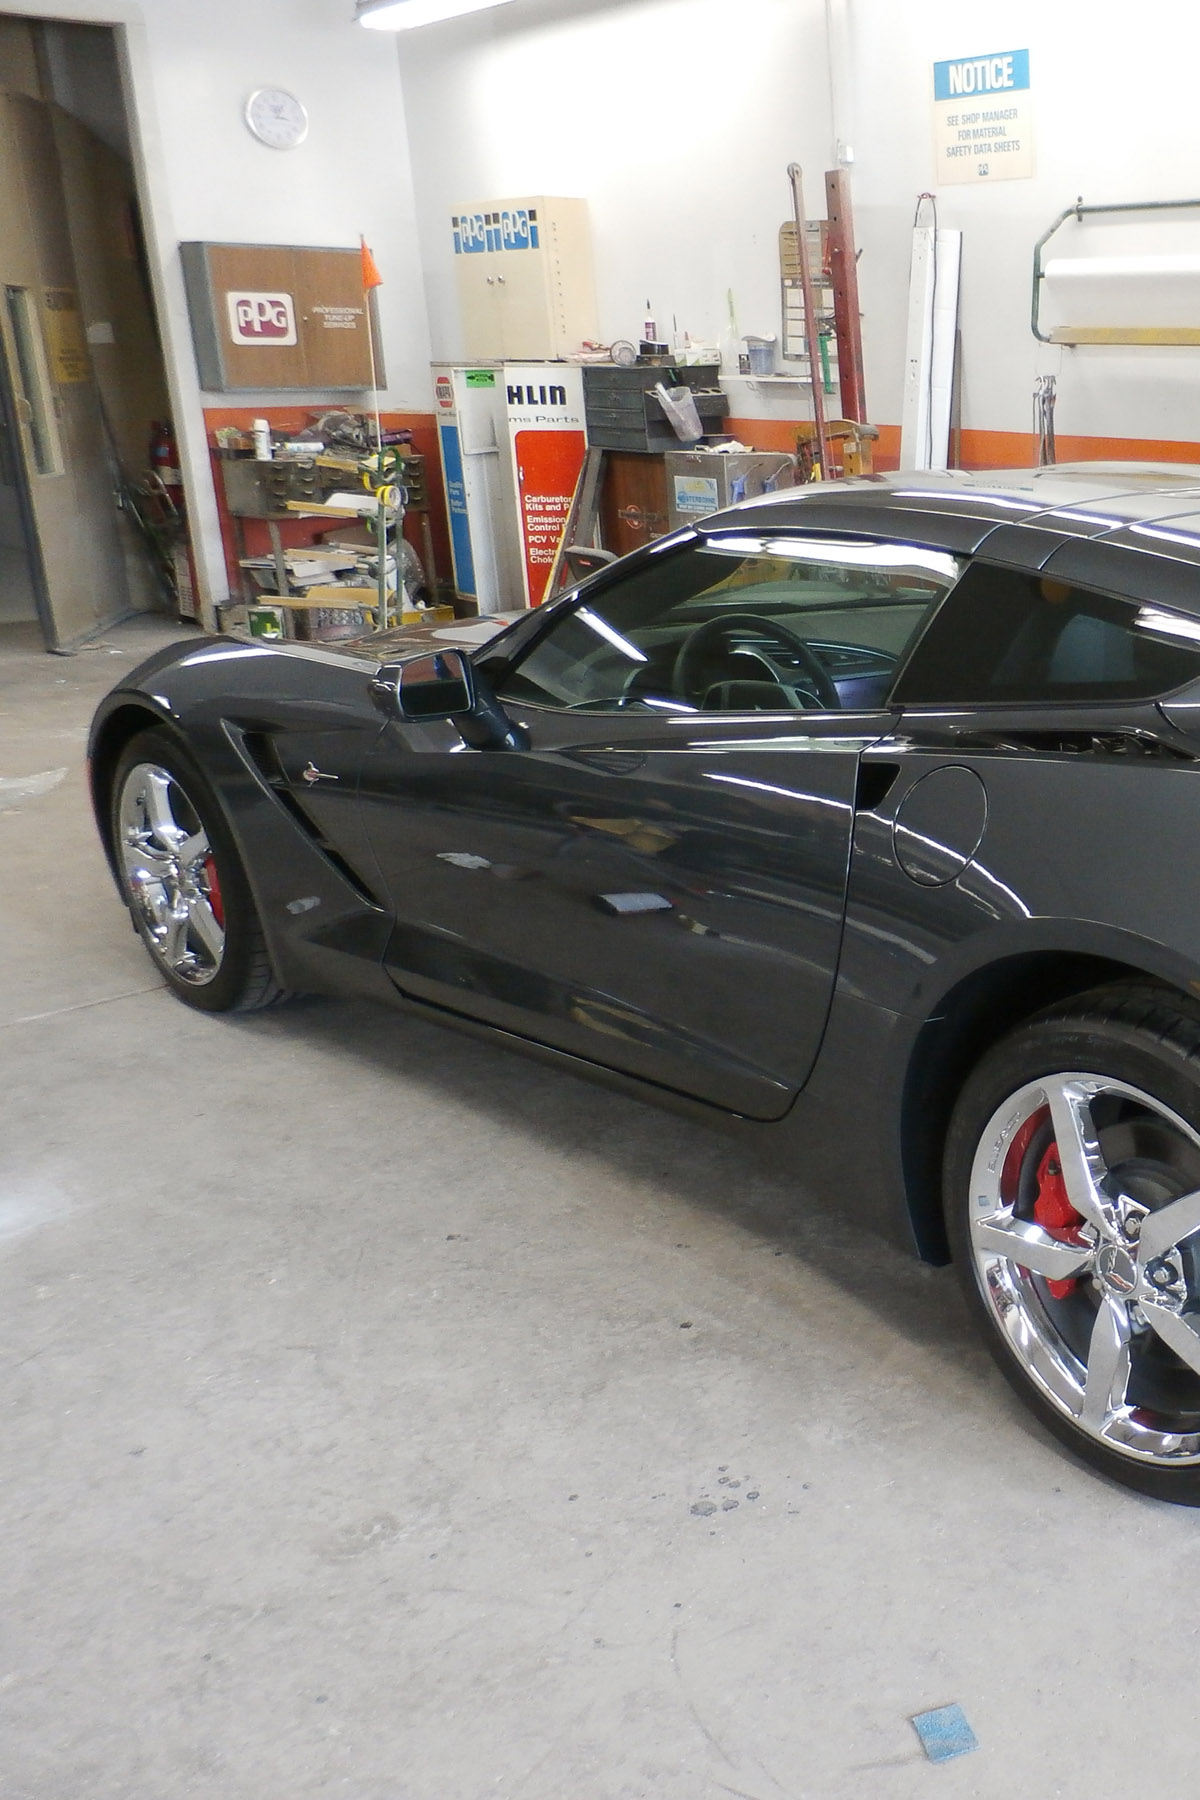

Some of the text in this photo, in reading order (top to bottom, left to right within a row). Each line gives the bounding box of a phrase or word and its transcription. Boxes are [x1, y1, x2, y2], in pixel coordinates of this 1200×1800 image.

[948, 56, 1014, 95] NOTICE
[946, 108, 1018, 127] SEE SHOP MANAGER
[958, 126, 1007, 141] FOR MATERIAL
[946, 140, 1020, 158] SAFETY DATA SHEETS
[502, 211, 529, 244] PPG
[238, 299, 287, 332] PPG
[525, 503, 544, 511] Kits
[545, 503, 561, 511] and
[527, 515, 566, 523] Emission
[527, 523, 560, 531] Control
[528, 535, 562, 543] PCV Va
[530, 556, 558, 564] Chok
